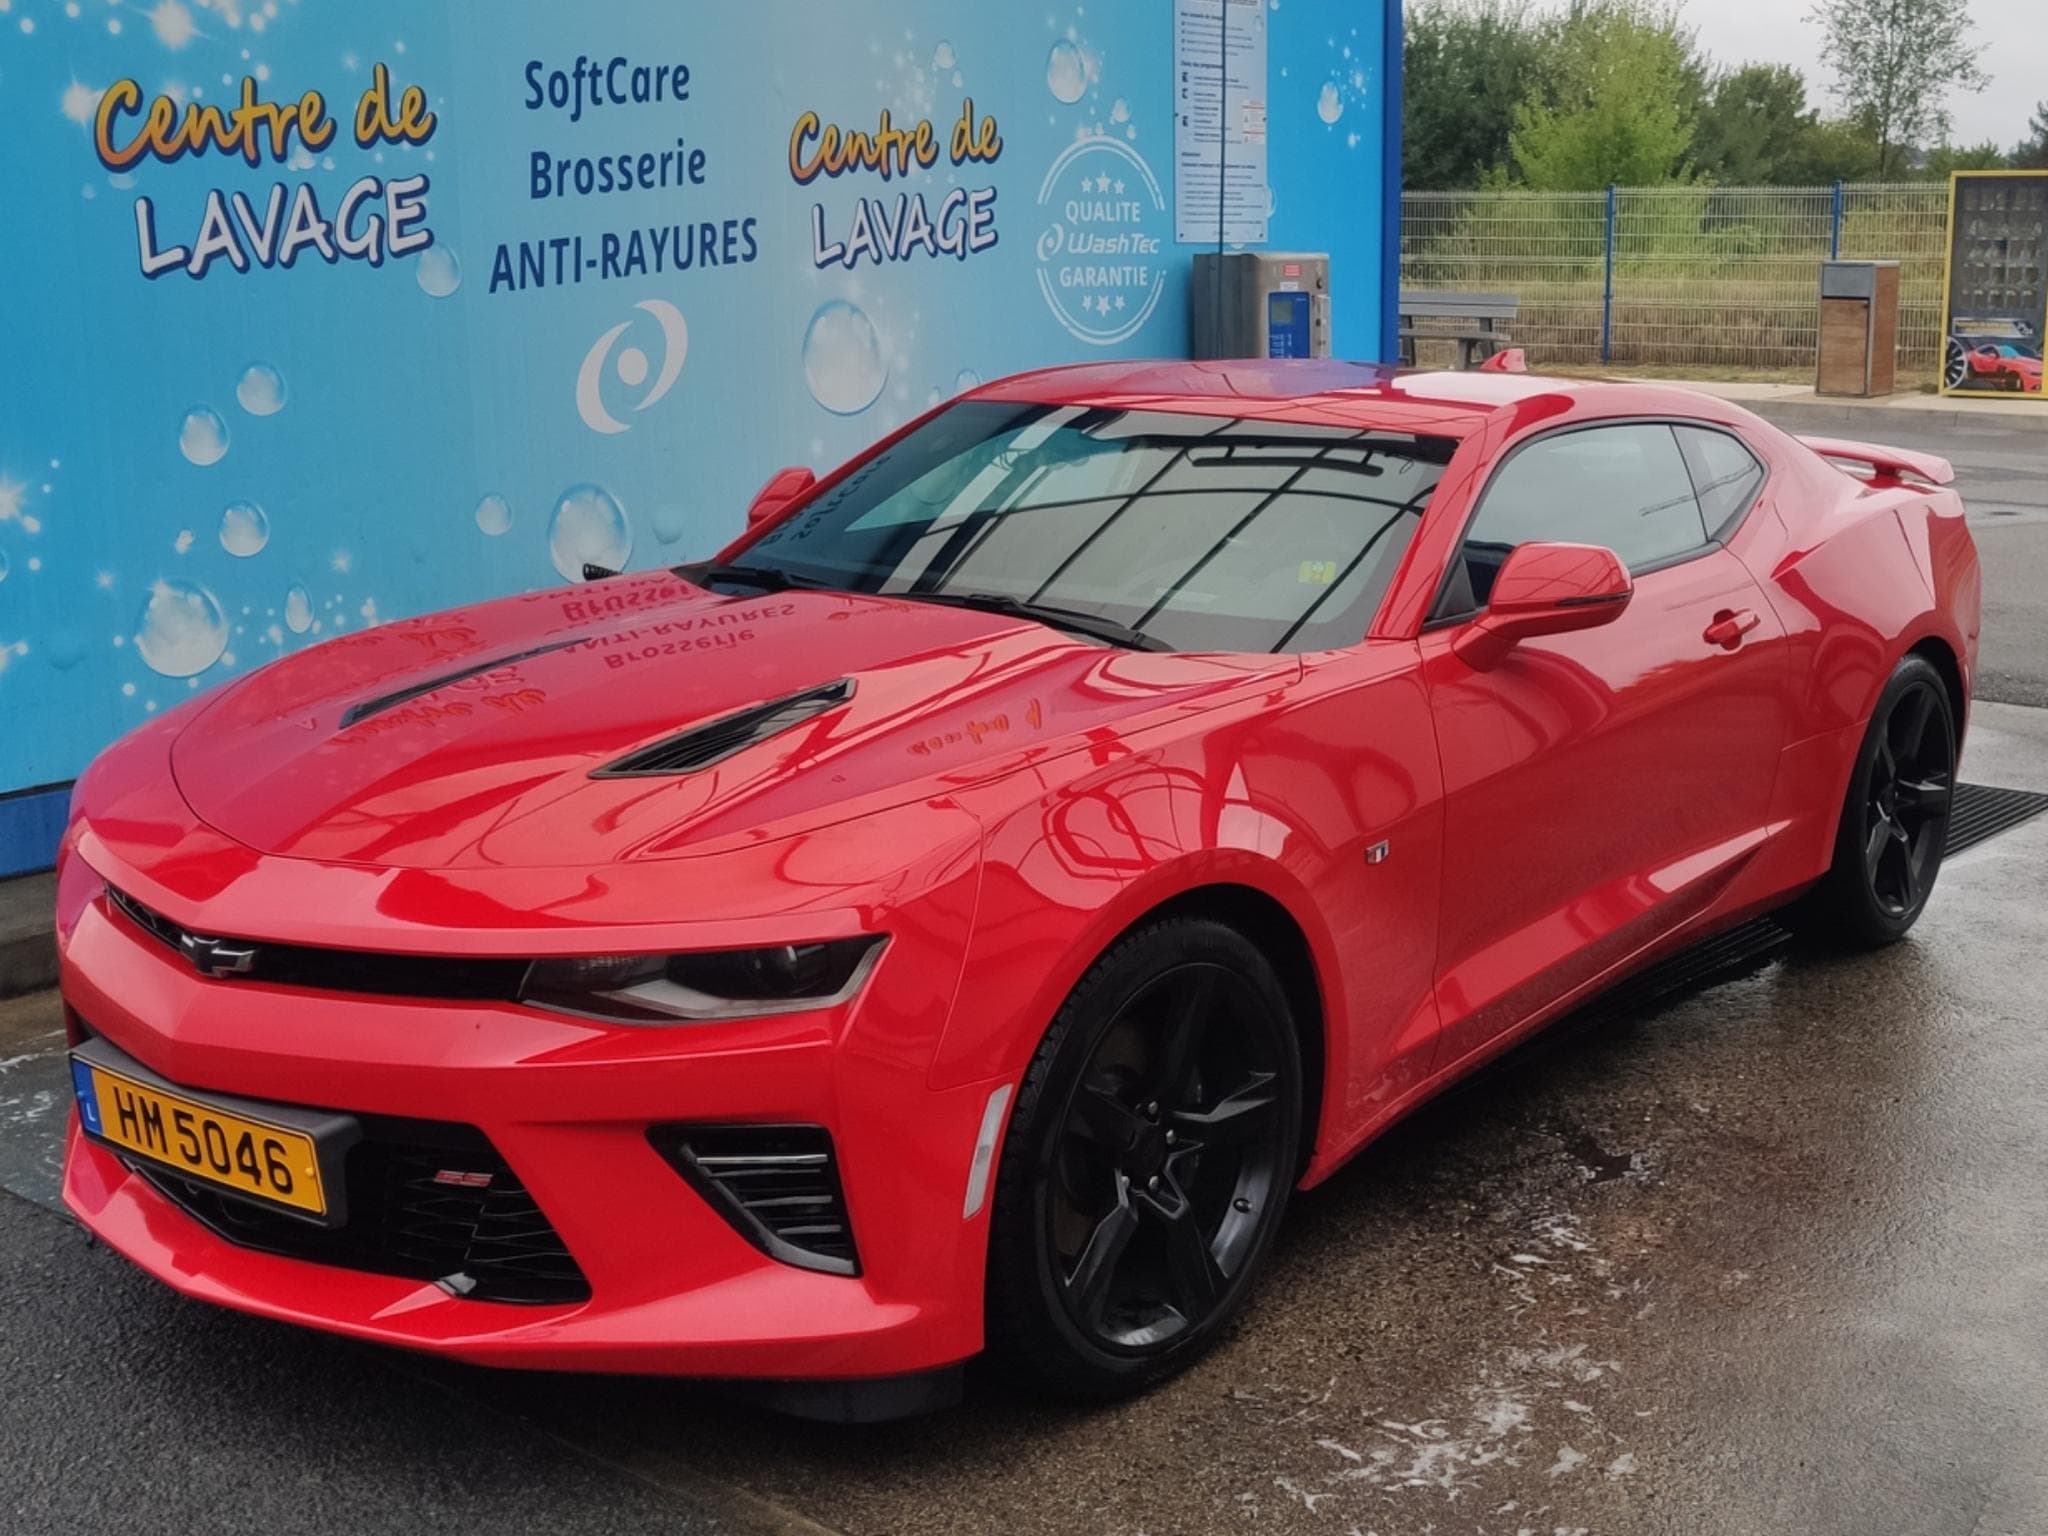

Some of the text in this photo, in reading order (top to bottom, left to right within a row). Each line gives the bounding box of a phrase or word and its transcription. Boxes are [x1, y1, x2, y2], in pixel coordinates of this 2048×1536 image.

[94, 62, 438, 174] Centre de
[525, 55, 690, 122] SoftCare
[530, 137, 706, 200] Brosserie
[789, 96, 1003, 186] Centre de
[135, 174, 435, 281] LAVAGE
[811, 185, 998, 270] LAVAGE
[1065, 200, 1141, 224] QUALITE
[1067, 232, 1161, 254] WashTec
[489, 217, 758, 294] ANTI-RAYURES
[1060, 266, 1148, 288] GARANTIE
[85, 1101, 96, 1122] L
[113, 1086, 294, 1195] HM 5046
